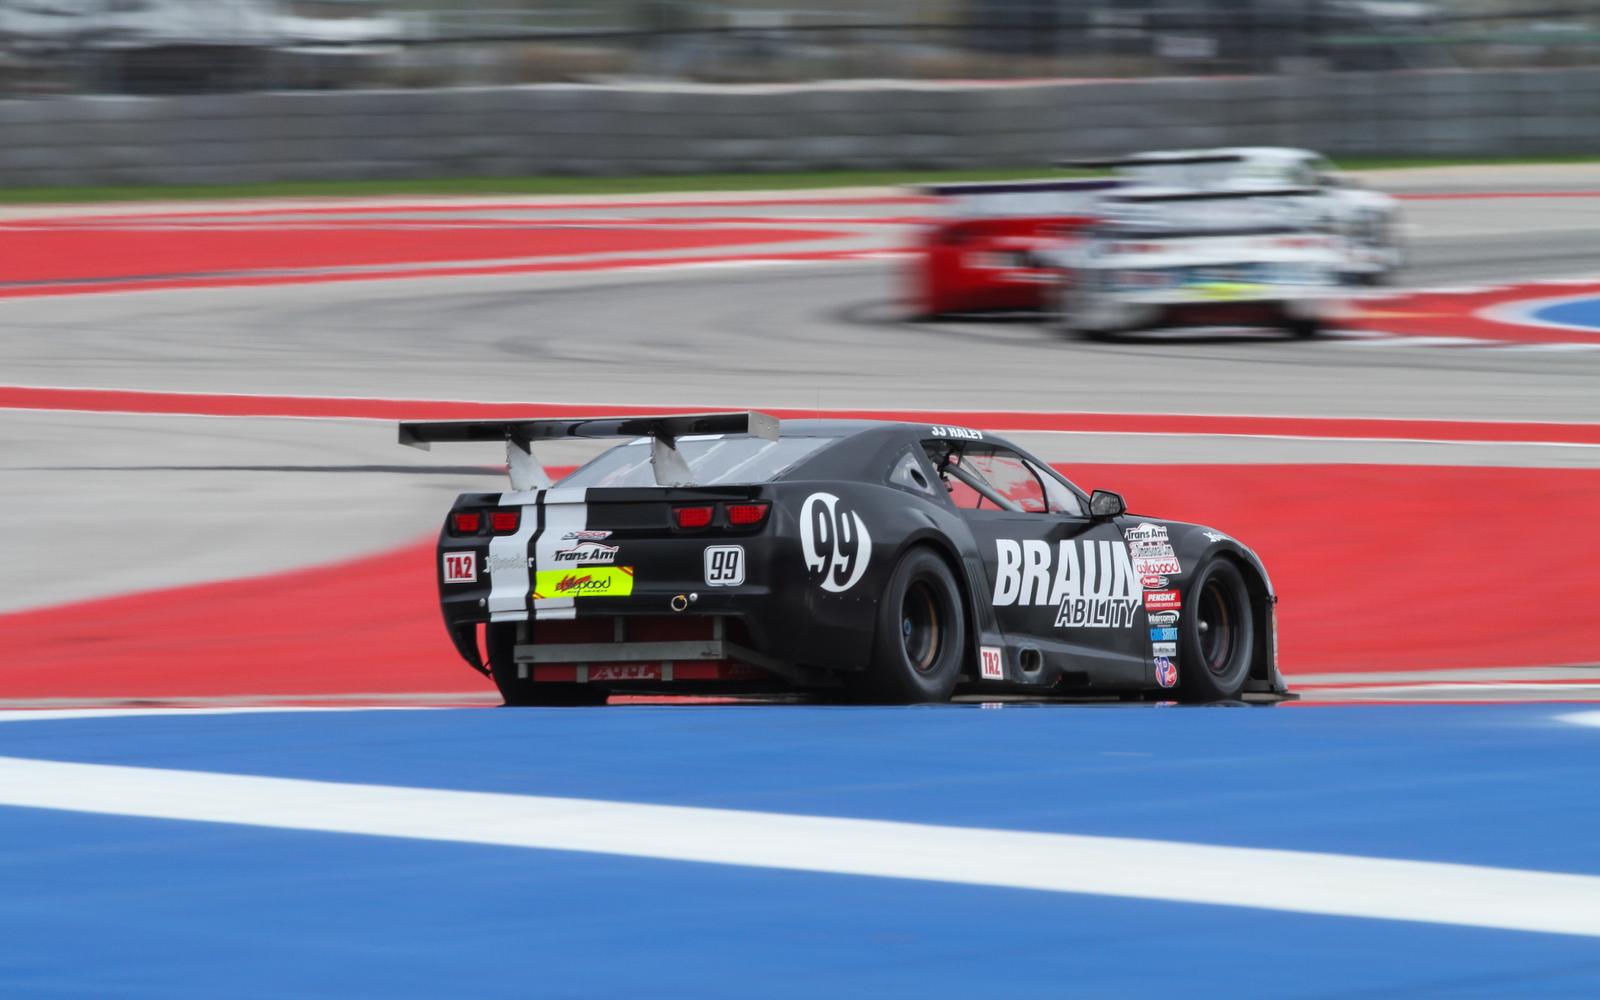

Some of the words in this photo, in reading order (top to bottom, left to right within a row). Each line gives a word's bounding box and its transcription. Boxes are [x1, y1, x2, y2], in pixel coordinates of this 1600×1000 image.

[932, 427, 947, 437] JJ
[947, 427, 983, 440] HALEY
[806, 497, 862, 589] 99
[1127, 530, 1150, 540] Trans
[1151, 528, 1167, 537] Am
[553, 550, 588, 562] Trans
[591, 549, 614, 560] Am
[710, 551, 739, 580] 99
[446, 556, 472, 580] TA2
[992, 539, 1143, 606] BRAUN
[1147, 592, 1176, 602] PENSKE
[1054, 598, 1138, 628] ABILITY
[983, 652, 1000, 675] TA2
